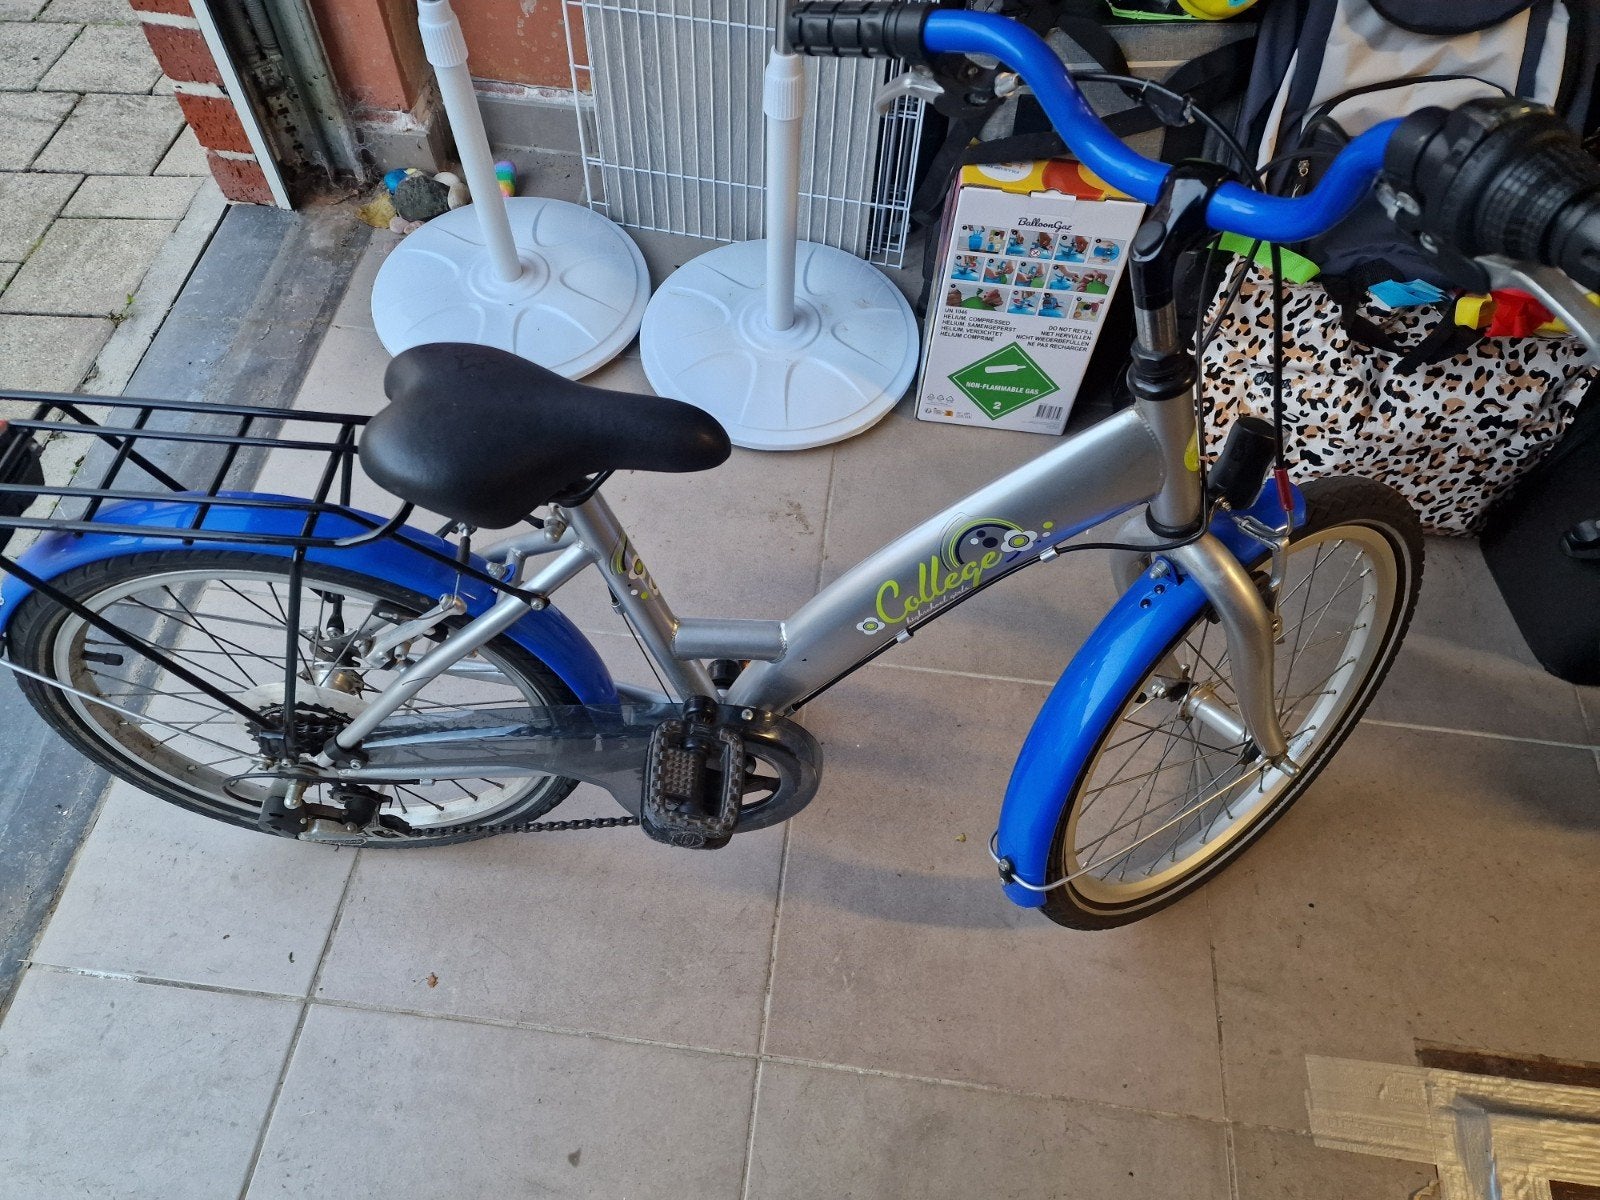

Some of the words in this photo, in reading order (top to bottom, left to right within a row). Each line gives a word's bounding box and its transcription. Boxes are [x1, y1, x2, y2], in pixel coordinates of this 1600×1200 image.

[1017, 217, 1072, 232] BalloonGaz
[968, 316, 1010, 326] COMPRESSED
[967, 322, 1017, 332] SAMENGEPERST
[966, 328, 1003, 337] VERDICHTET
[1055, 332, 1091, 340] HERVULLEN
[1049, 344, 1088, 352] RECHARGER
[966, 381, 1024, 394] NON-FLAMMABLE
[992, 401, 1002, 410] 2
[875, 551, 1002, 624] College
